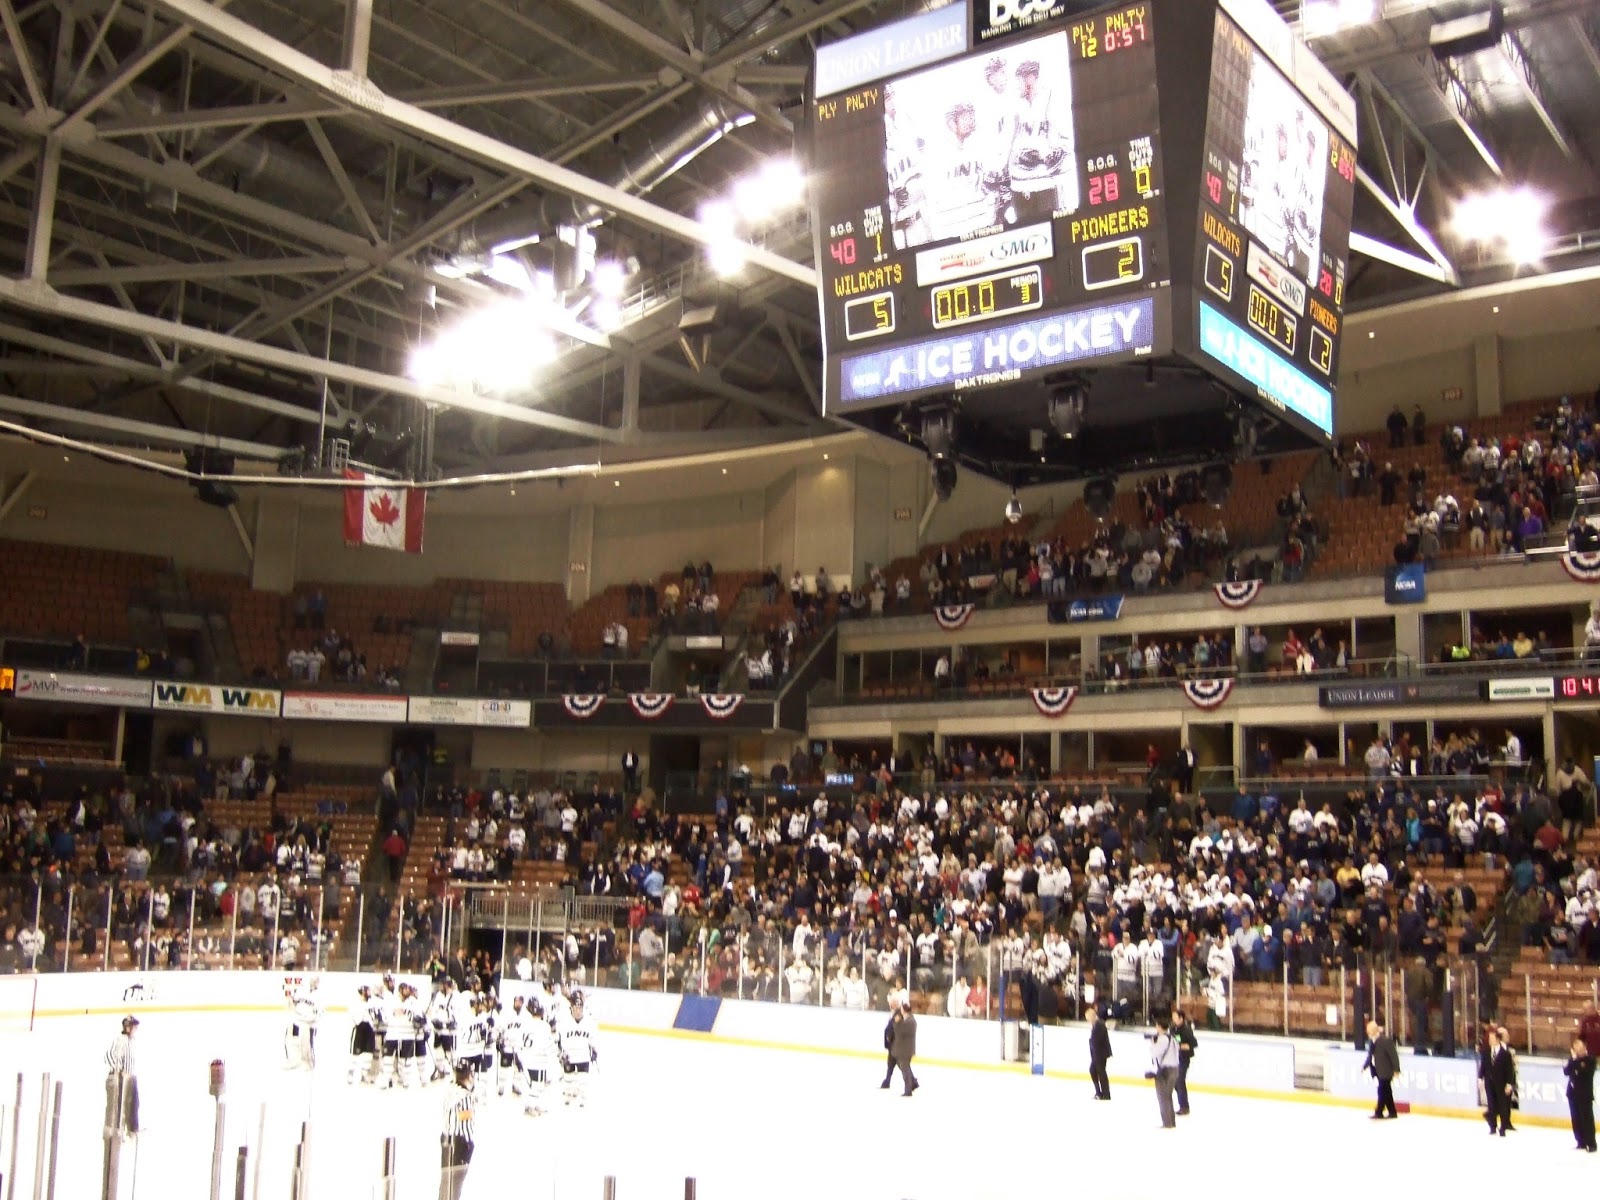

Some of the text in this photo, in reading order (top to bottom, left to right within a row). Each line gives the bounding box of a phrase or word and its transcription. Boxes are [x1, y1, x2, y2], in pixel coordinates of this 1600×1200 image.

[1072, 7, 1145, 44] PLY PNLTY
[1081, 25, 1146, 58] 12 0:57
[819, 23, 962, 84] UNION LEADER
[818, 88, 878, 122] PLY PNLTY
[1088, 172, 1119, 206] 28
[1135, 166, 1151, 194] 0
[1205, 170, 1222, 205] 40
[1071, 205, 1149, 243] PIONEERS
[1203, 211, 1241, 258] WILDCATS
[830, 238, 857, 266] 40
[875, 232, 883, 258] 1
[998, 238, 1037, 259] SMG
[1118, 243, 1134, 278] 2
[834, 263, 902, 298] WILDCATS
[1219, 262, 1231, 295] 5
[874, 298, 889, 330] 5
[917, 341, 973, 383] ICE
[984, 308, 1141, 369] HOCKEY
[1285, 325, 1293, 346] 3
[1321, 338, 1331, 369] 2
[32, 680, 59, 693] MVP
[156, 684, 213, 704] WM
[221, 688, 277, 709] WM
[1327, 687, 1395, 702] UNION LEADER
[1434, 1071, 1471, 1095] ICE
